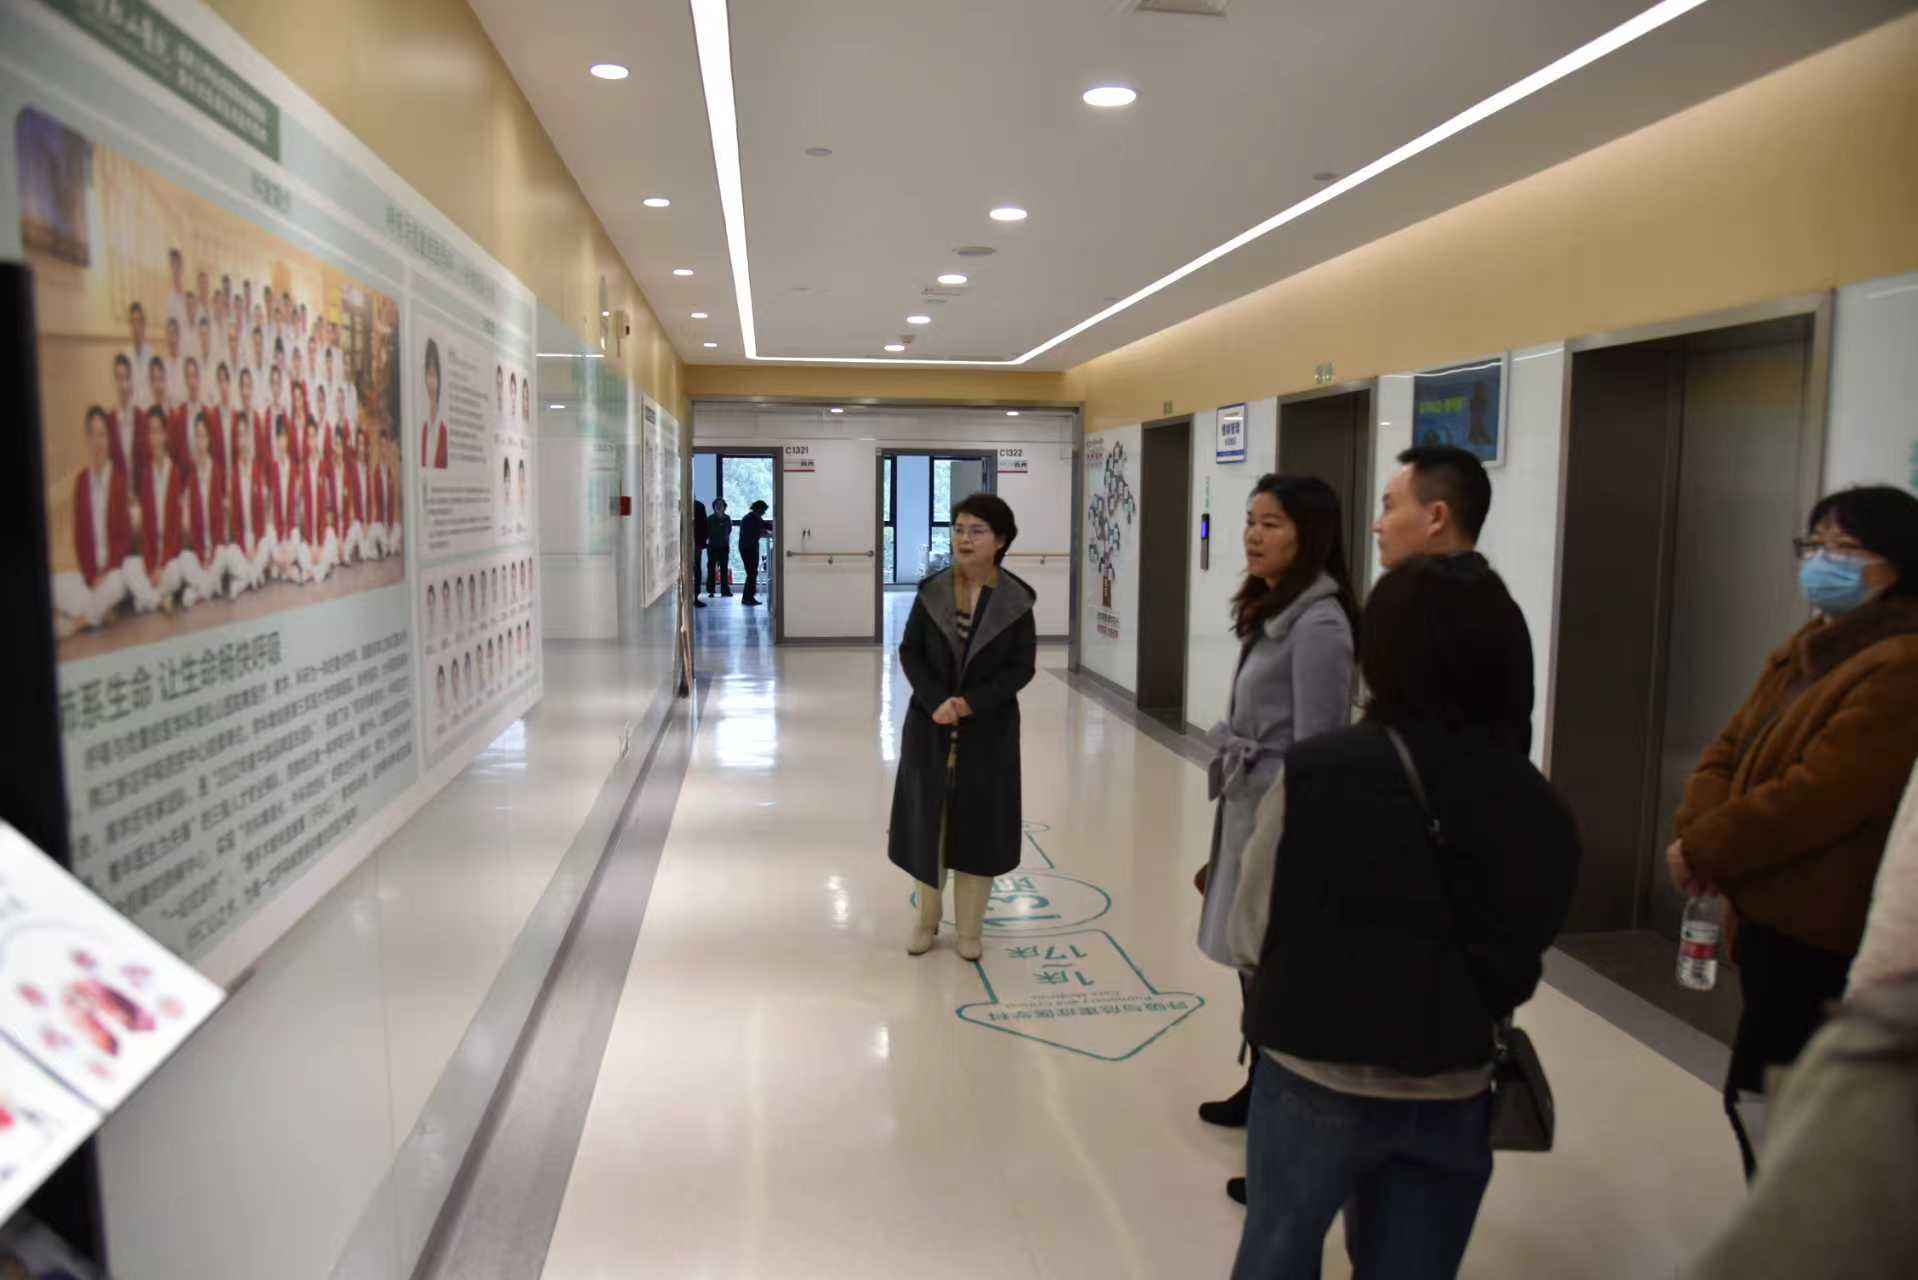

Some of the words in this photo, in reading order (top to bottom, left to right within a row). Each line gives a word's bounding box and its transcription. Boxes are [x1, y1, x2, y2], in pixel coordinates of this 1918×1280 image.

[999, 449, 1024, 457] C1322
[1005, 944, 1088, 959] 17床
[1032, 971, 1095, 986] 1床
